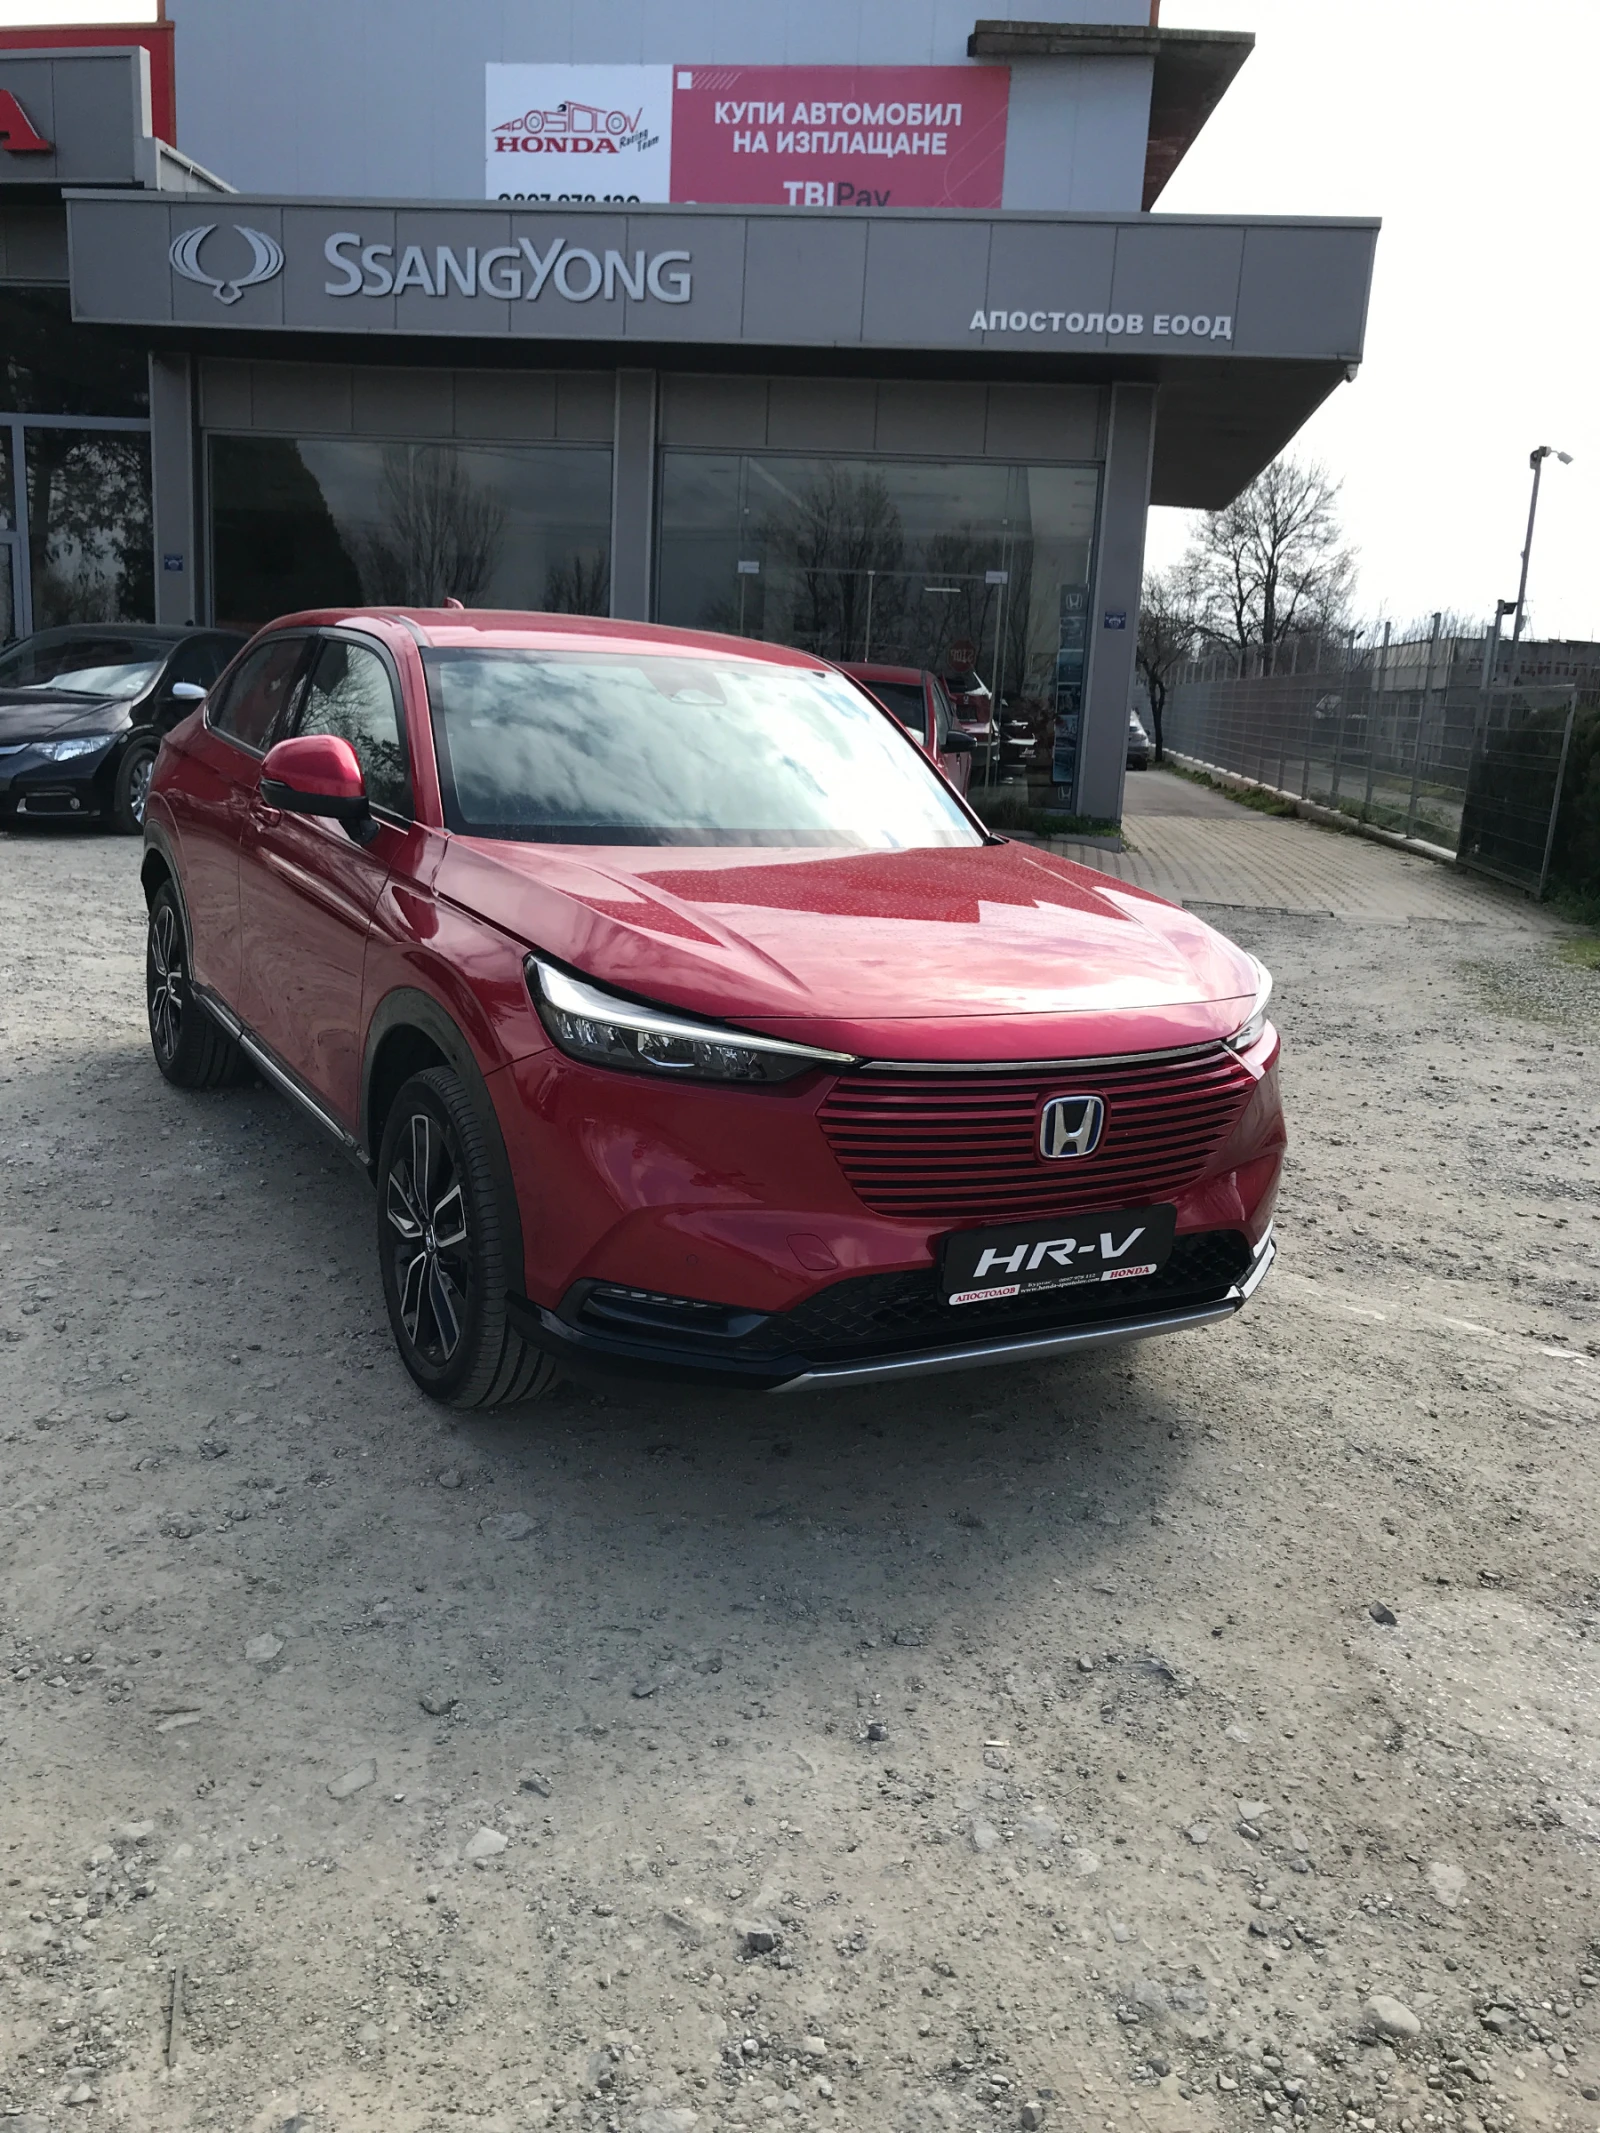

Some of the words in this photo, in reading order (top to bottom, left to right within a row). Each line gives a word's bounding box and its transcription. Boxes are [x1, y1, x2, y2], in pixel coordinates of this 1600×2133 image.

[714, 102, 785, 125] КУПИ
[792, 102, 962, 127] АВТОМОБИЛ
[495, 137, 619, 153] HONDA
[733, 131, 767, 154] НА
[777, 131, 947, 158] ИЗПЛАЩАНЕ
[969, 310, 1144, 335] АПОСТОЛОВ
[1152, 314, 1233, 340] ЕООД
[973, 1227, 1146, 1277] HR-V
[1109, 1265, 1150, 1279] HONDA
